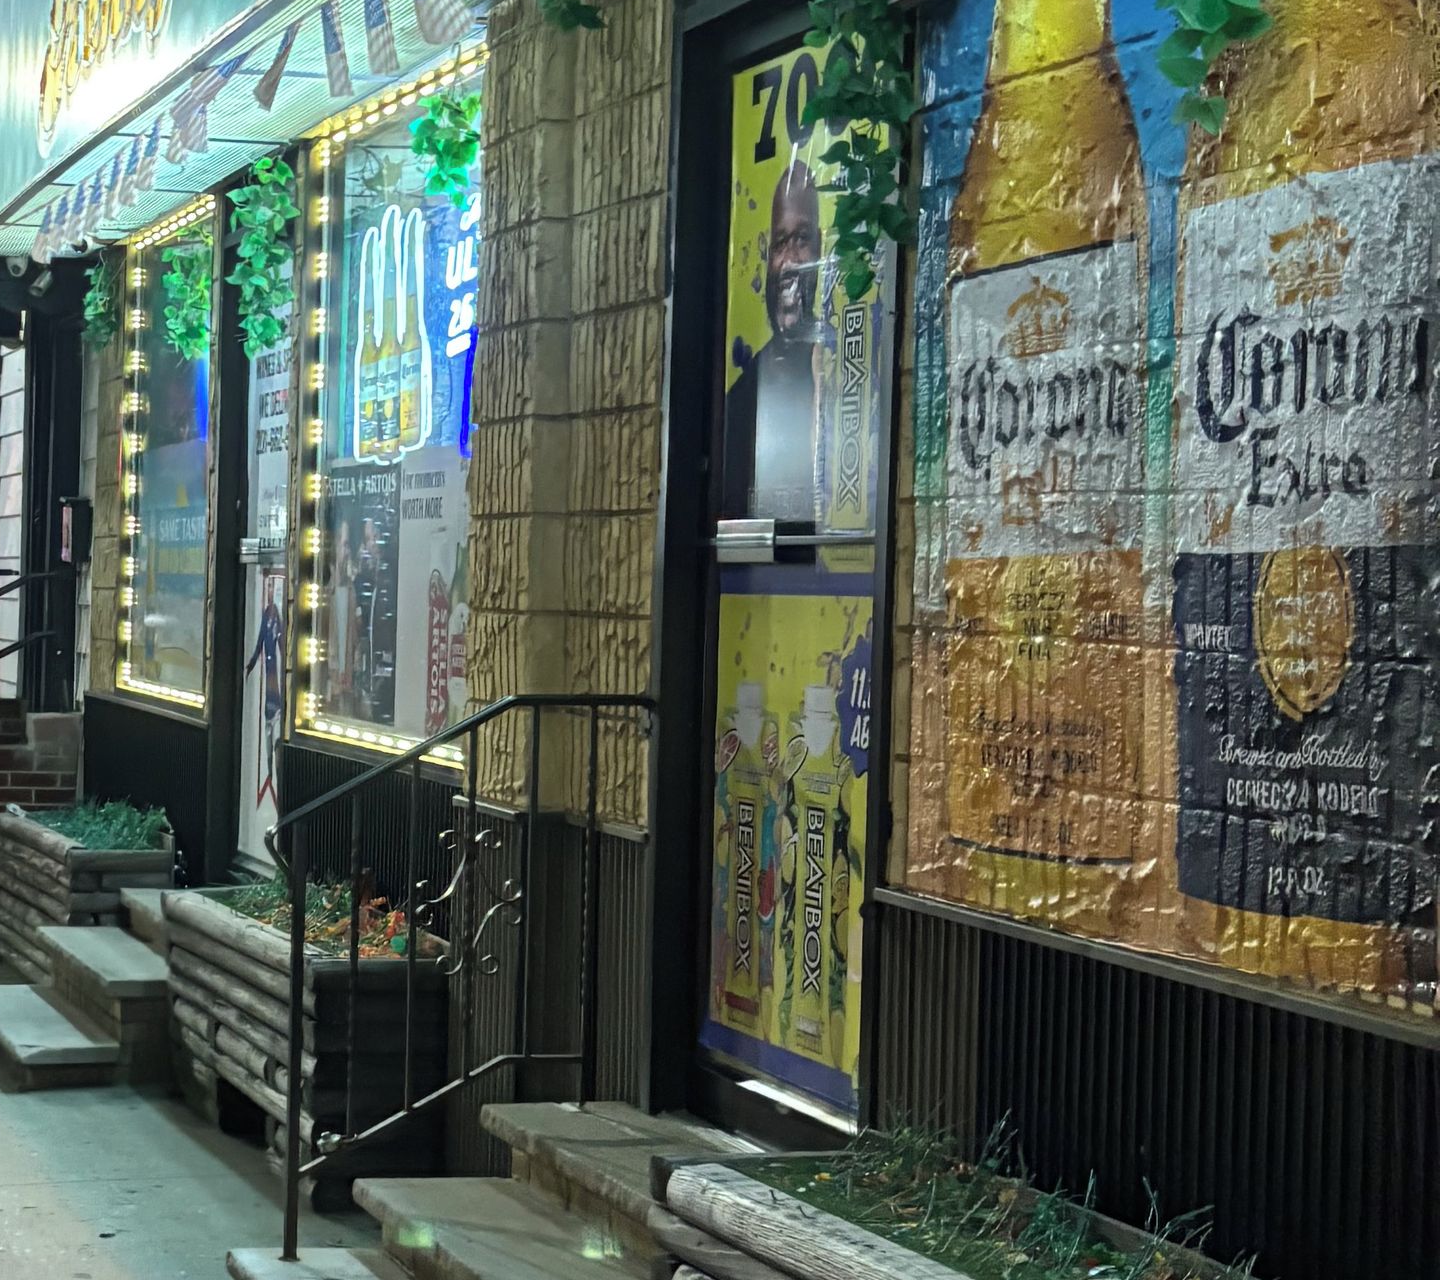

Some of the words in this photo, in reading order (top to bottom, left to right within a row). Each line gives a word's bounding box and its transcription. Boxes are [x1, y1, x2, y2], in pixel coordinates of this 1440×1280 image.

[1196, 303, 1429, 443] Corona
[960, 355, 1131, 480] Corona
[328, 477, 356, 497] STELLA
[364, 473, 396, 494] ARTOIS
[1247, 424, 1371, 508] Extra
[402, 498, 423, 520] WORTH
